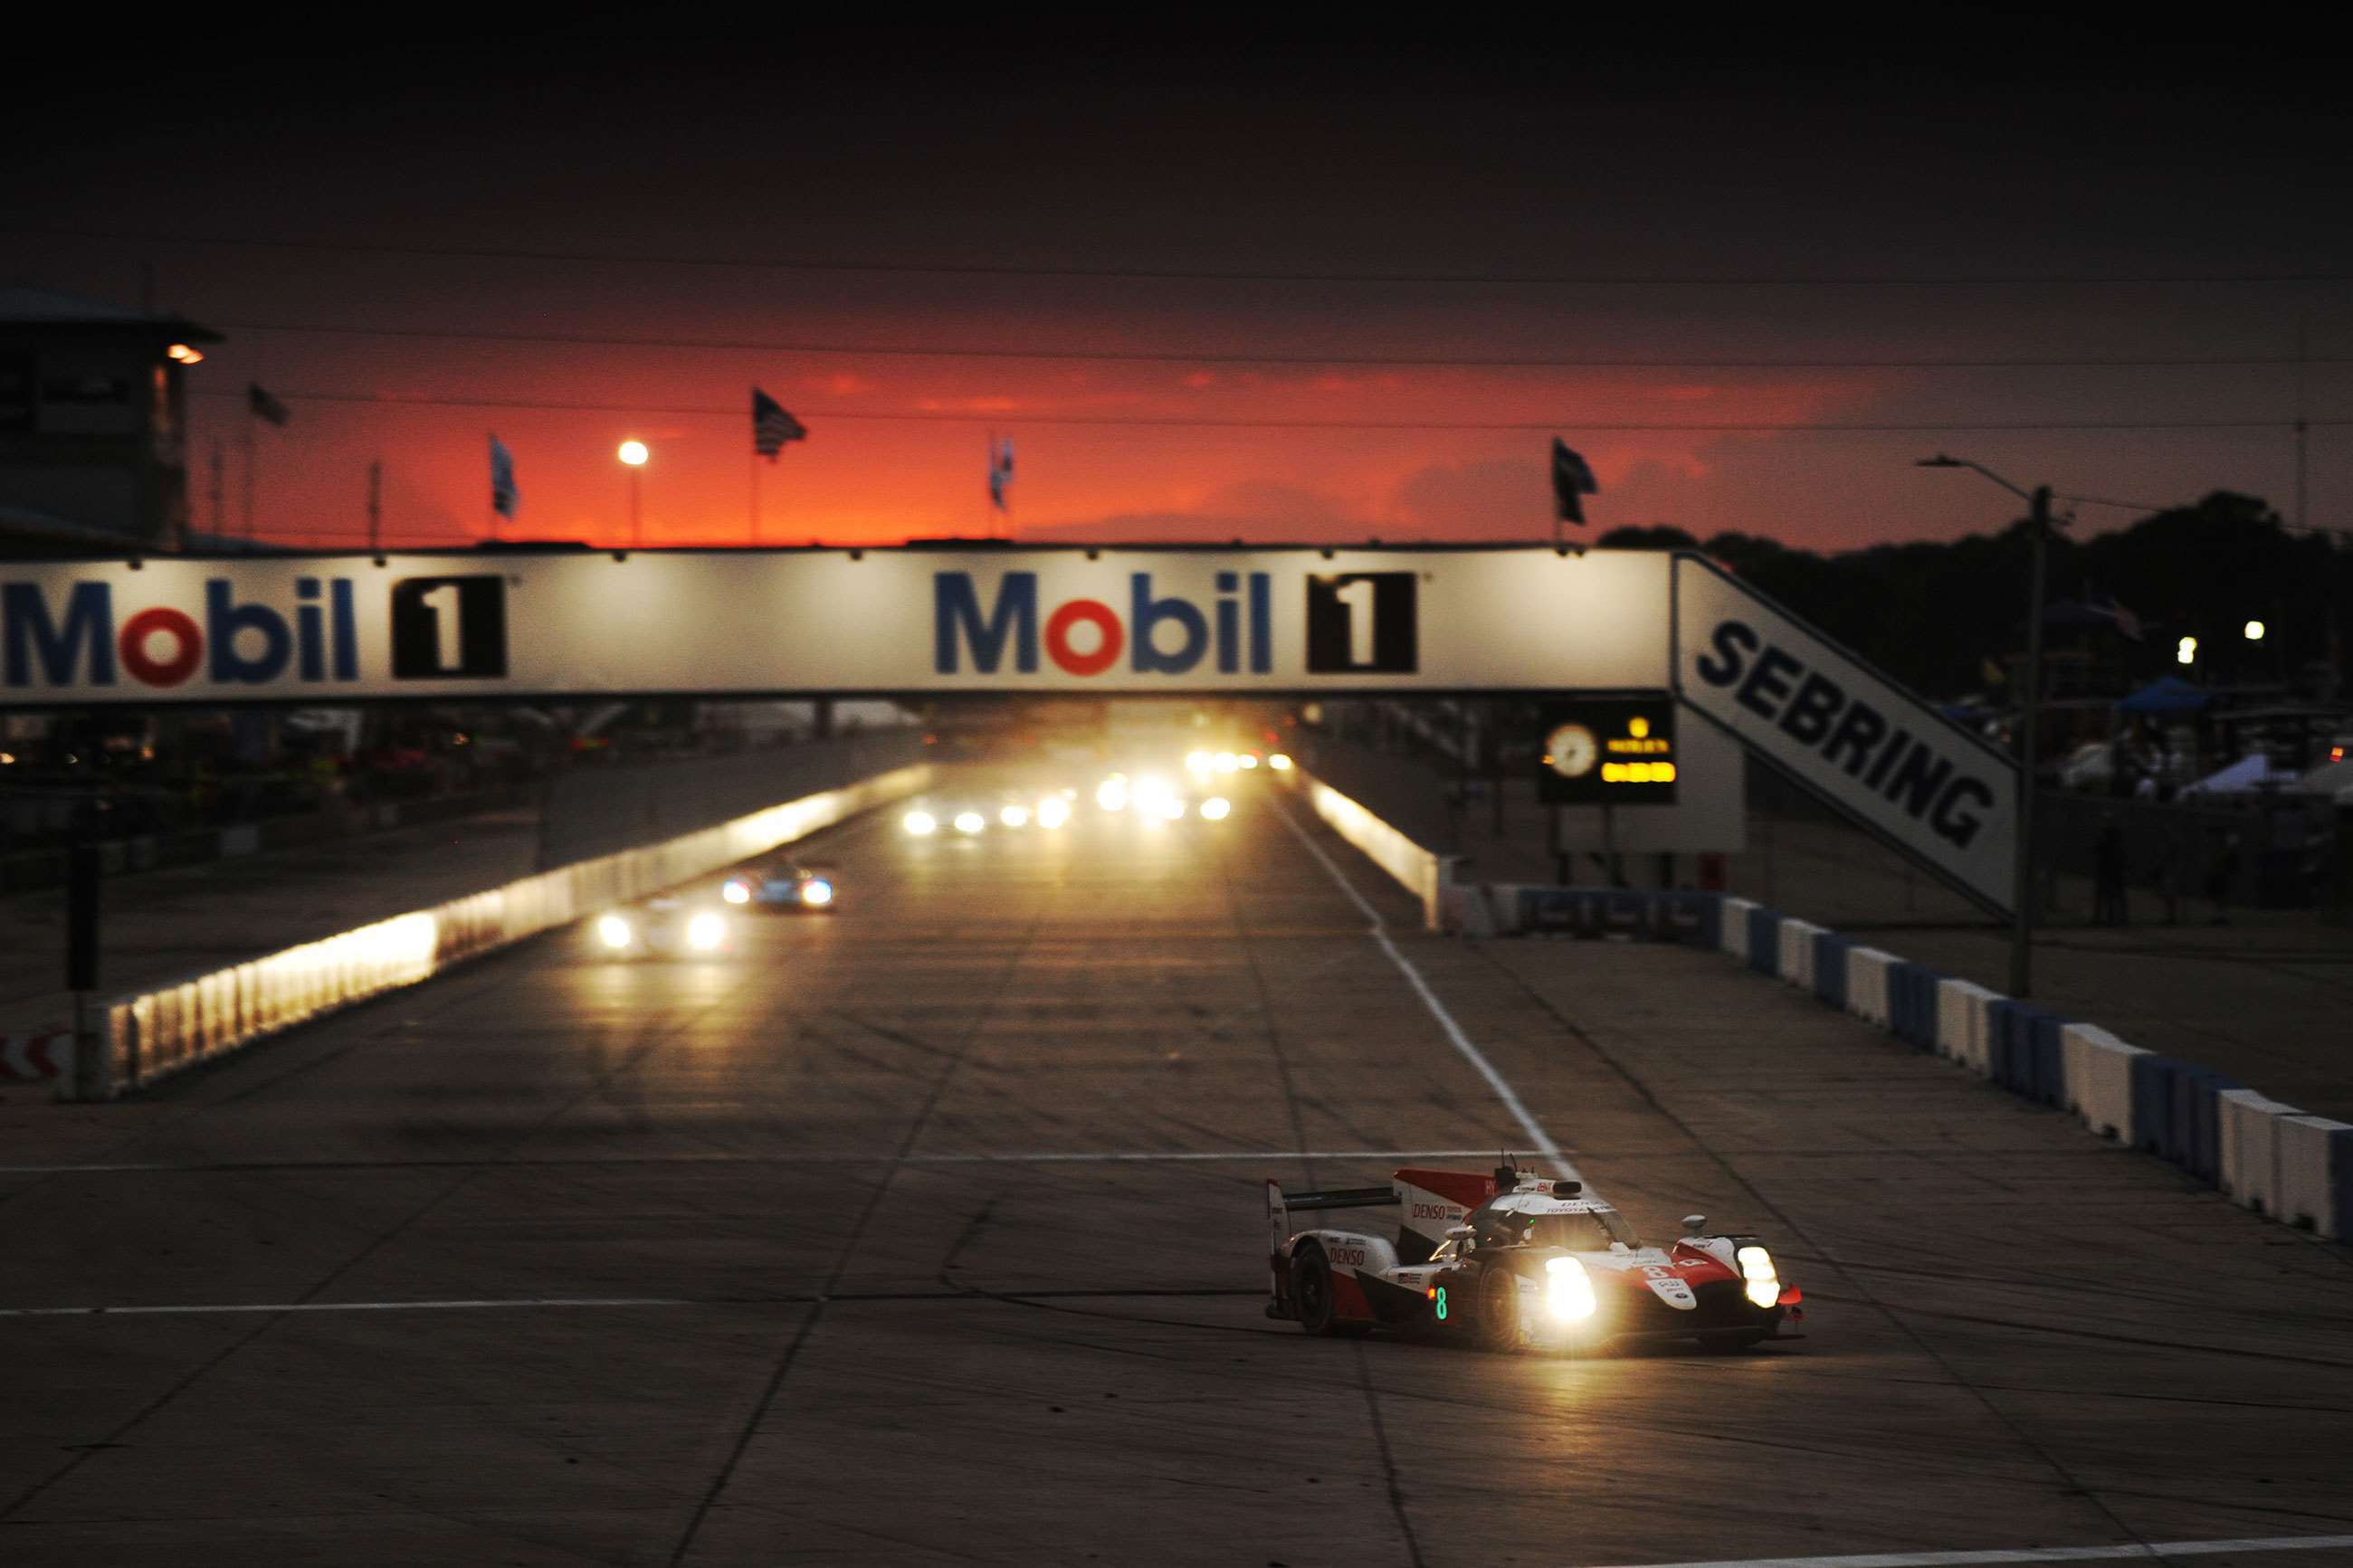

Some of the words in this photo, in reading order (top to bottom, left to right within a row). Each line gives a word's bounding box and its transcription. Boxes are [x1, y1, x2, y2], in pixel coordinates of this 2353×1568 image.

[2, 579, 358, 686] Mobil
[934, 572, 1272, 676] Mobil
[1696, 620, 1994, 849] SEBRING
[1413, 1203, 1446, 1220] DENSO
[1330, 1247, 1366, 1267] DENSO
[1436, 1286, 1448, 1320] 8
